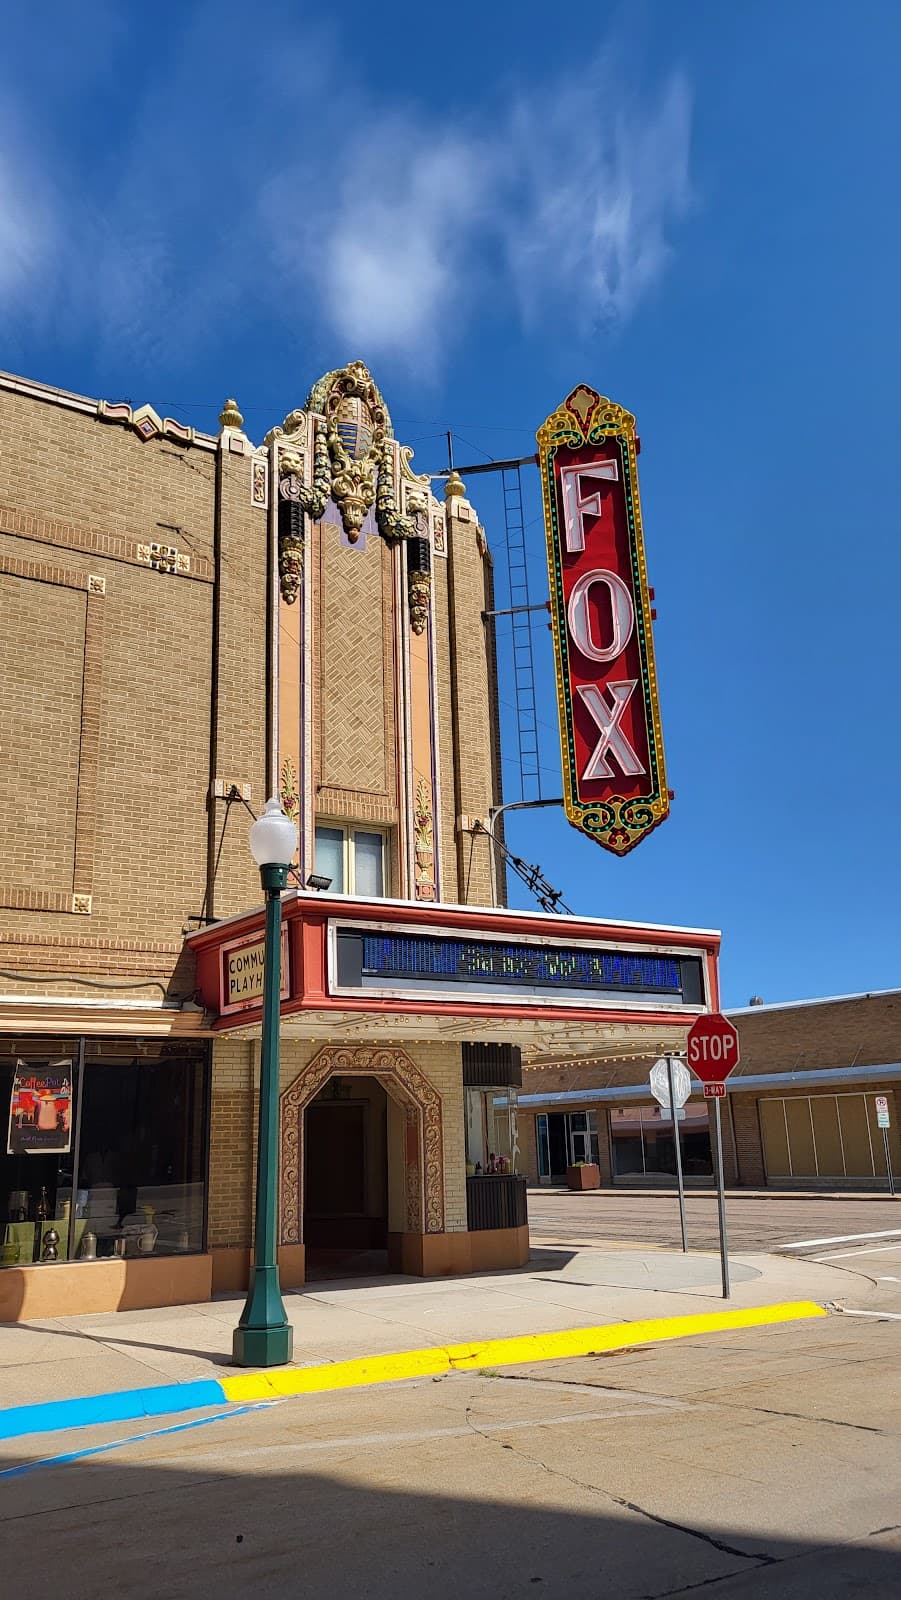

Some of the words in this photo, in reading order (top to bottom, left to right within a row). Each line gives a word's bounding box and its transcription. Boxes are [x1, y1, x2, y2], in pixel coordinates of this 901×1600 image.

[560, 459, 646, 780] FOX
[229, 950, 265, 974] COMMU
[230, 971, 263, 995] PLAYH
[690, 1034, 735, 1062] STOP
[705, 1085, 724, 1095] 3-WAY
